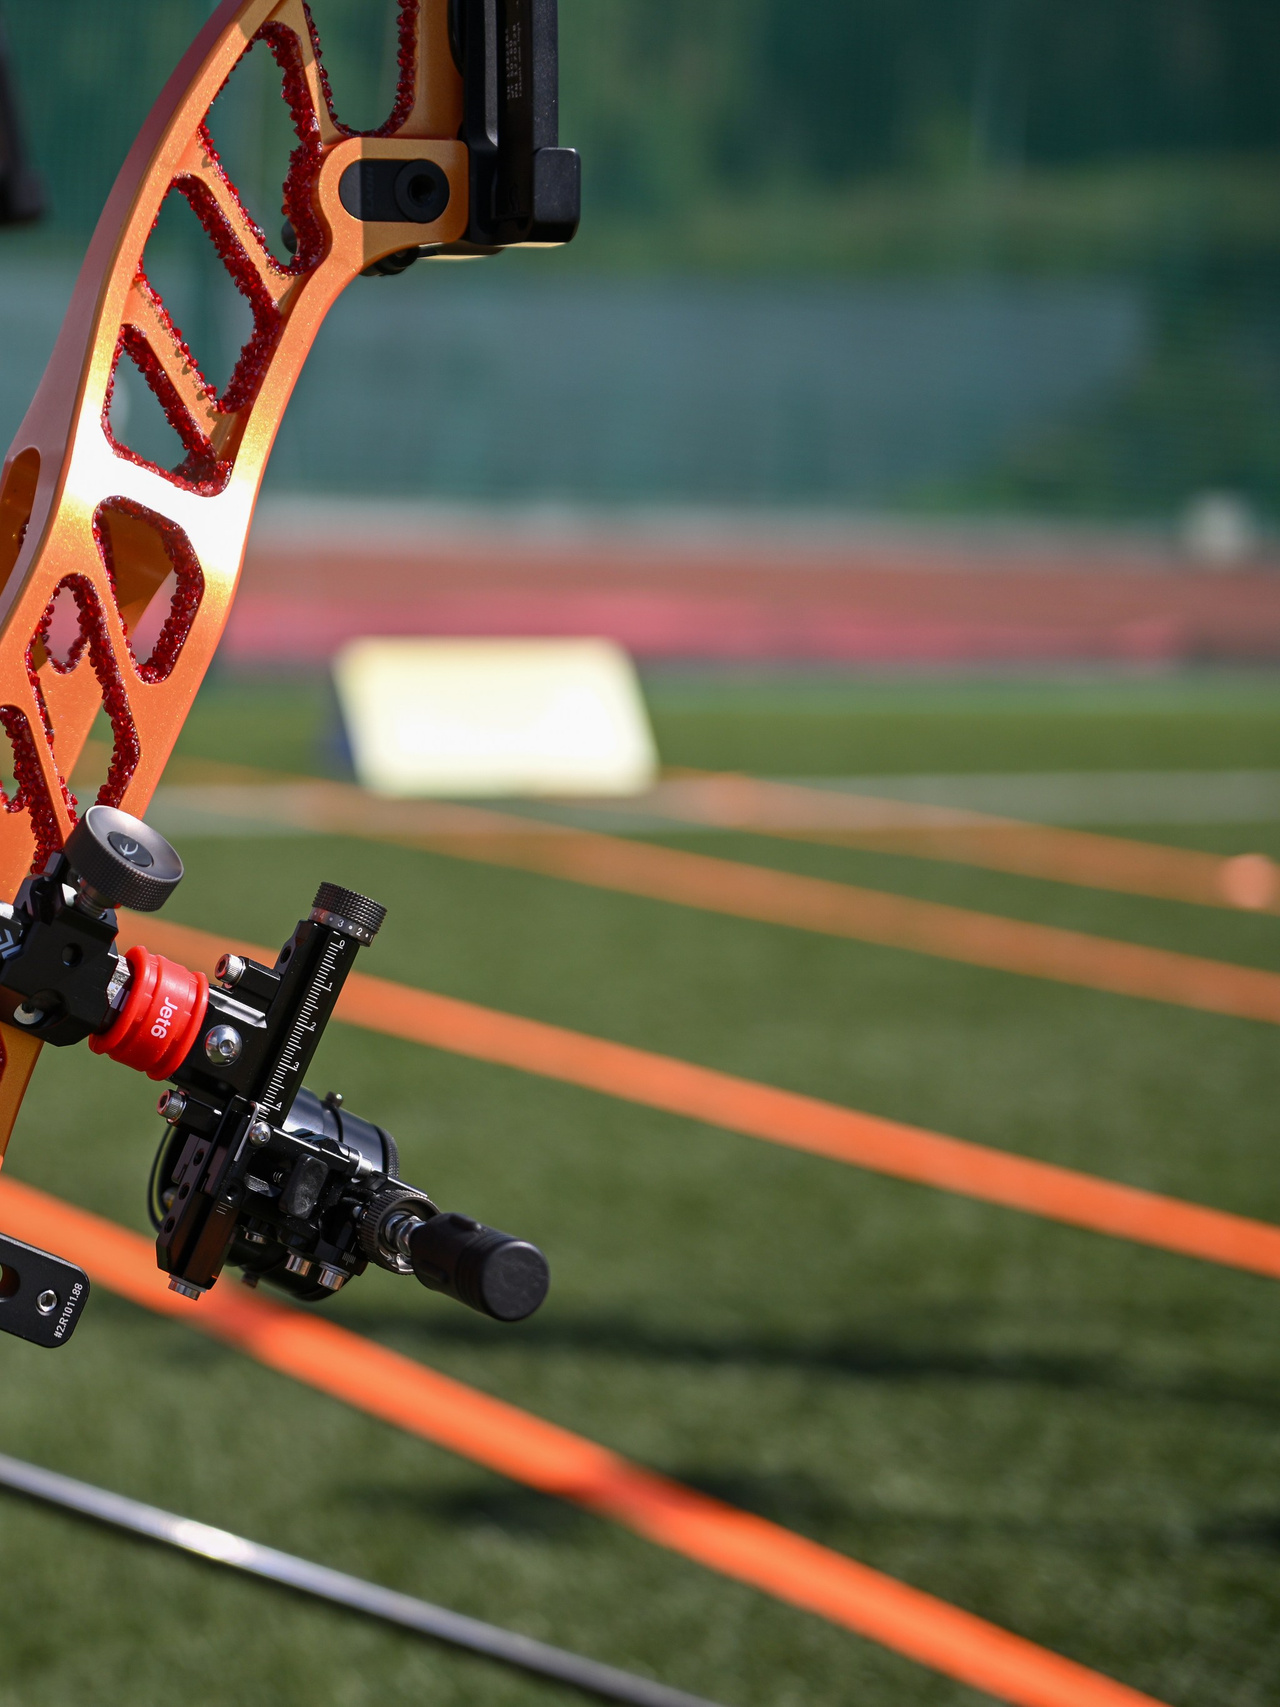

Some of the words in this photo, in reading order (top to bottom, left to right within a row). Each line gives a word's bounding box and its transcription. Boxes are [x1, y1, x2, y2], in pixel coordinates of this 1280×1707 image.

[337, 919, 345, 927] 3
[356, 928, 363, 936] 2
[339, 939, 345, 947] 0
[150, 996, 178, 1039] Jet6
